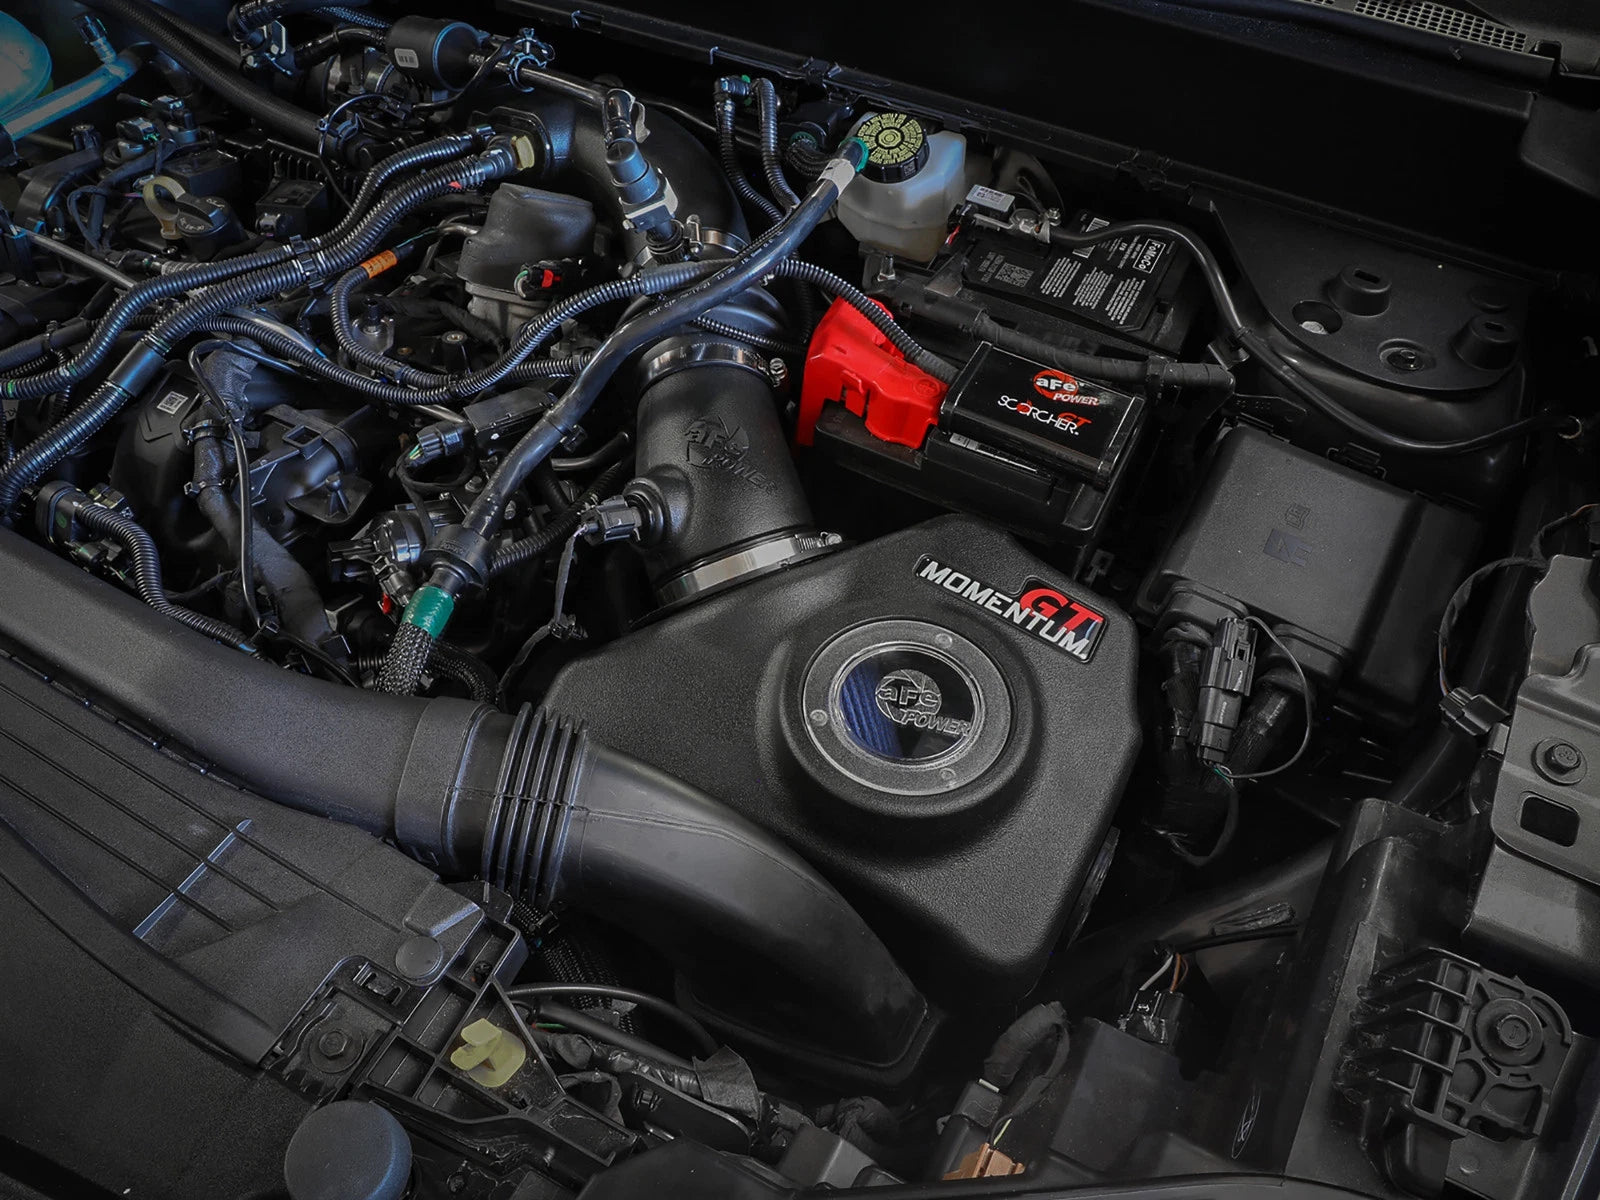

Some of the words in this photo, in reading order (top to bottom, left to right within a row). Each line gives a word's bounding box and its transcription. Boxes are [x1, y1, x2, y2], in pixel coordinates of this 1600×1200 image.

[1138, 241, 1161, 270] FoMoCo
[1034, 375, 1077, 393] aFe
[1053, 392, 1099, 406] POWER
[1058, 411, 1093, 428] GT
[919, 560, 1087, 659] MOMENTUM
[1019, 587, 1105, 634] GT
[876, 685, 940, 708] aFe
[898, 709, 972, 737] POWER
